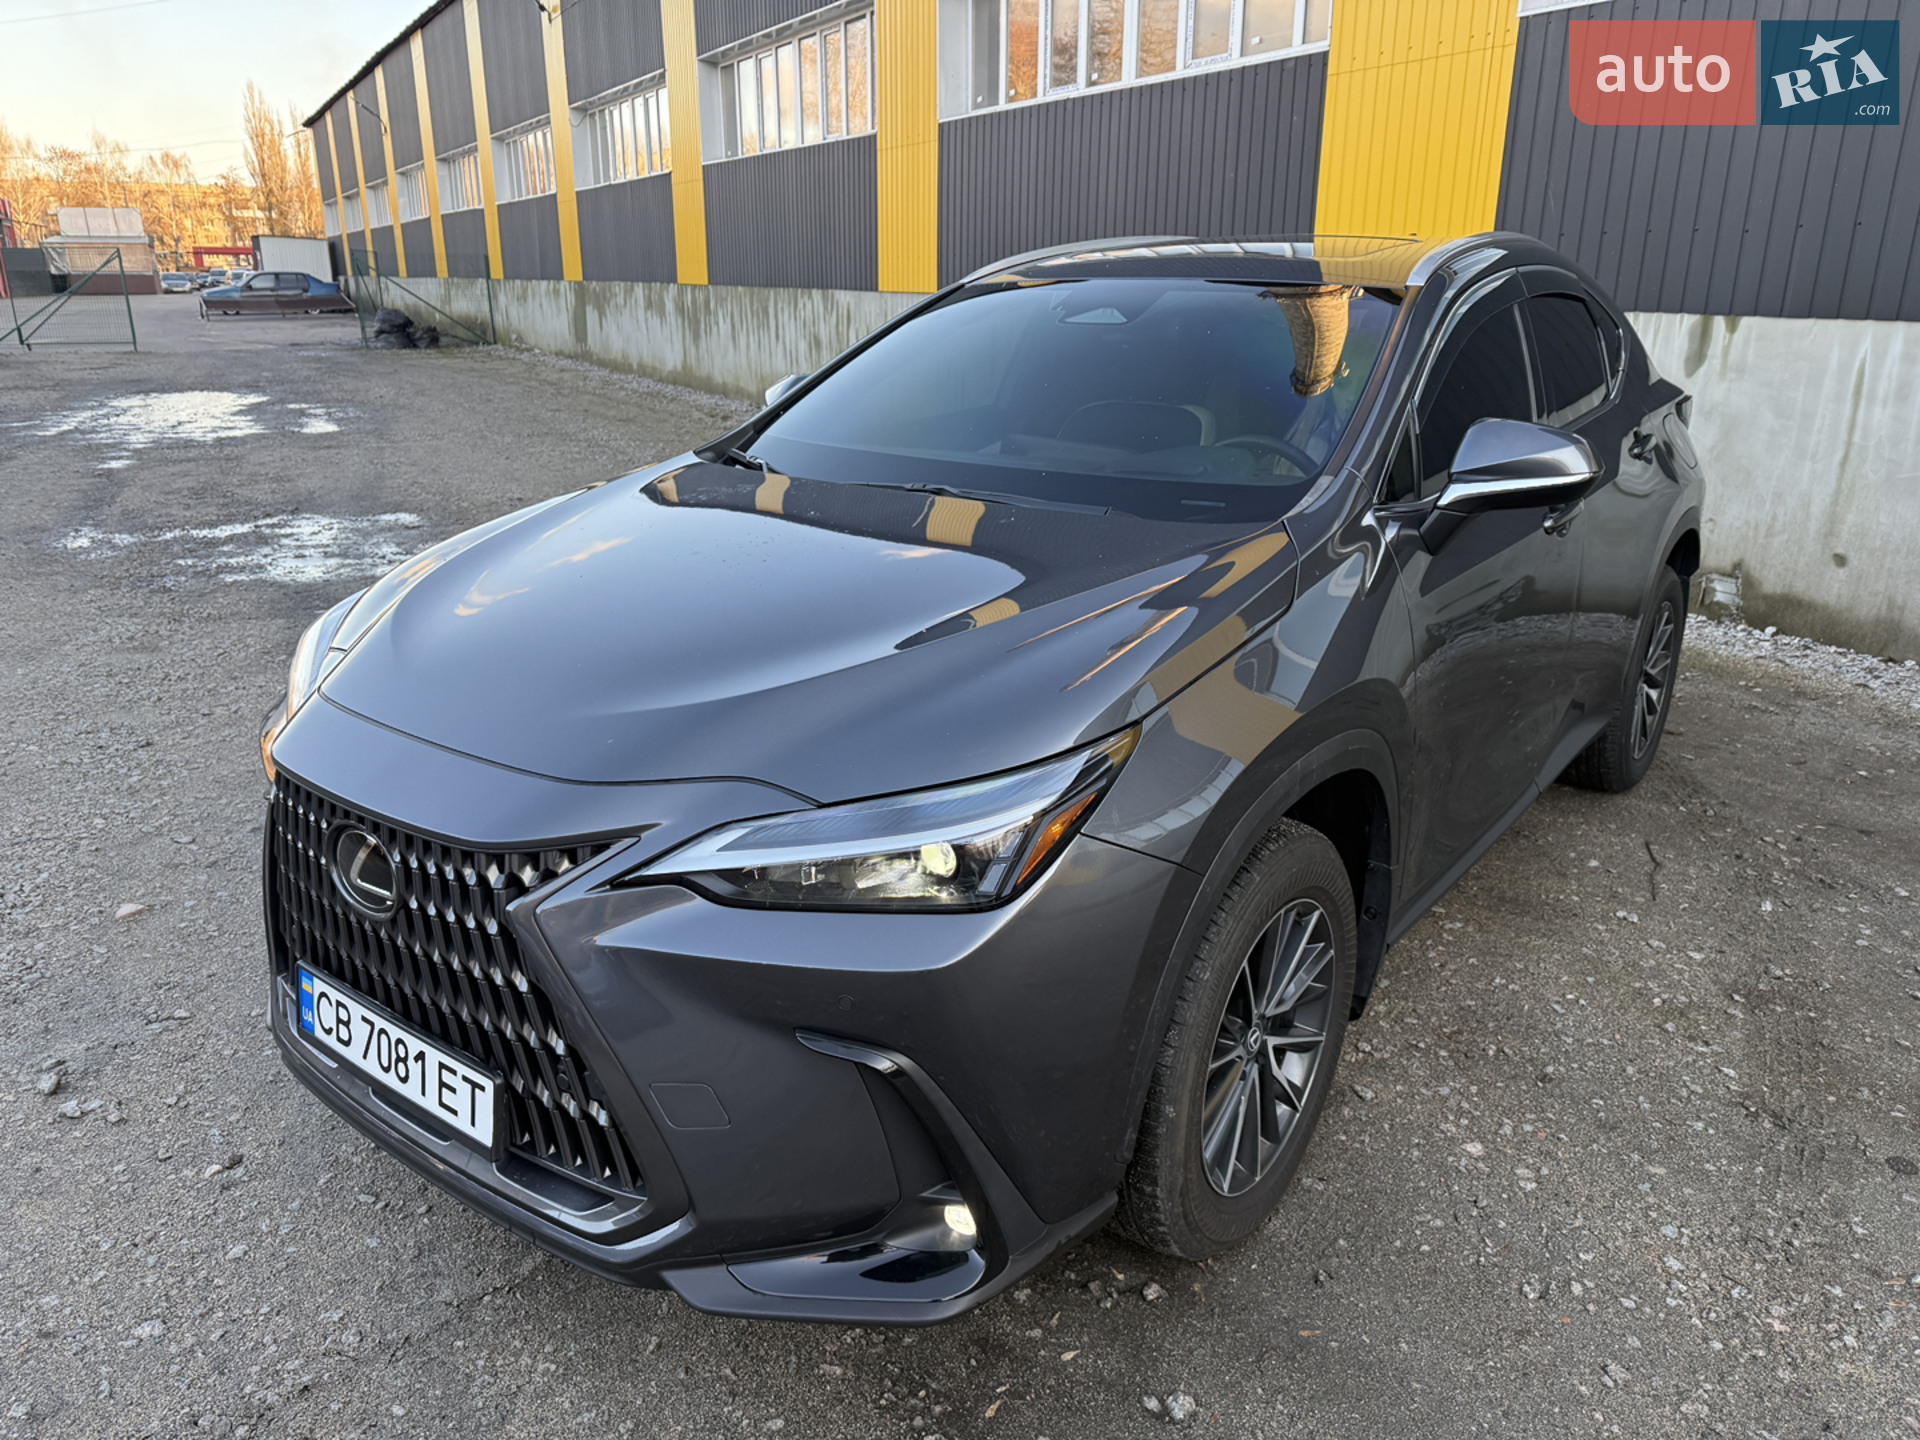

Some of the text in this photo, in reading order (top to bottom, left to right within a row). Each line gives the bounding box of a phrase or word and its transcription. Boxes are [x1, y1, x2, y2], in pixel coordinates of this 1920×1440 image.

[302, 1005, 314, 1025] UA
[316, 991, 486, 1128] CB 7081 ET
